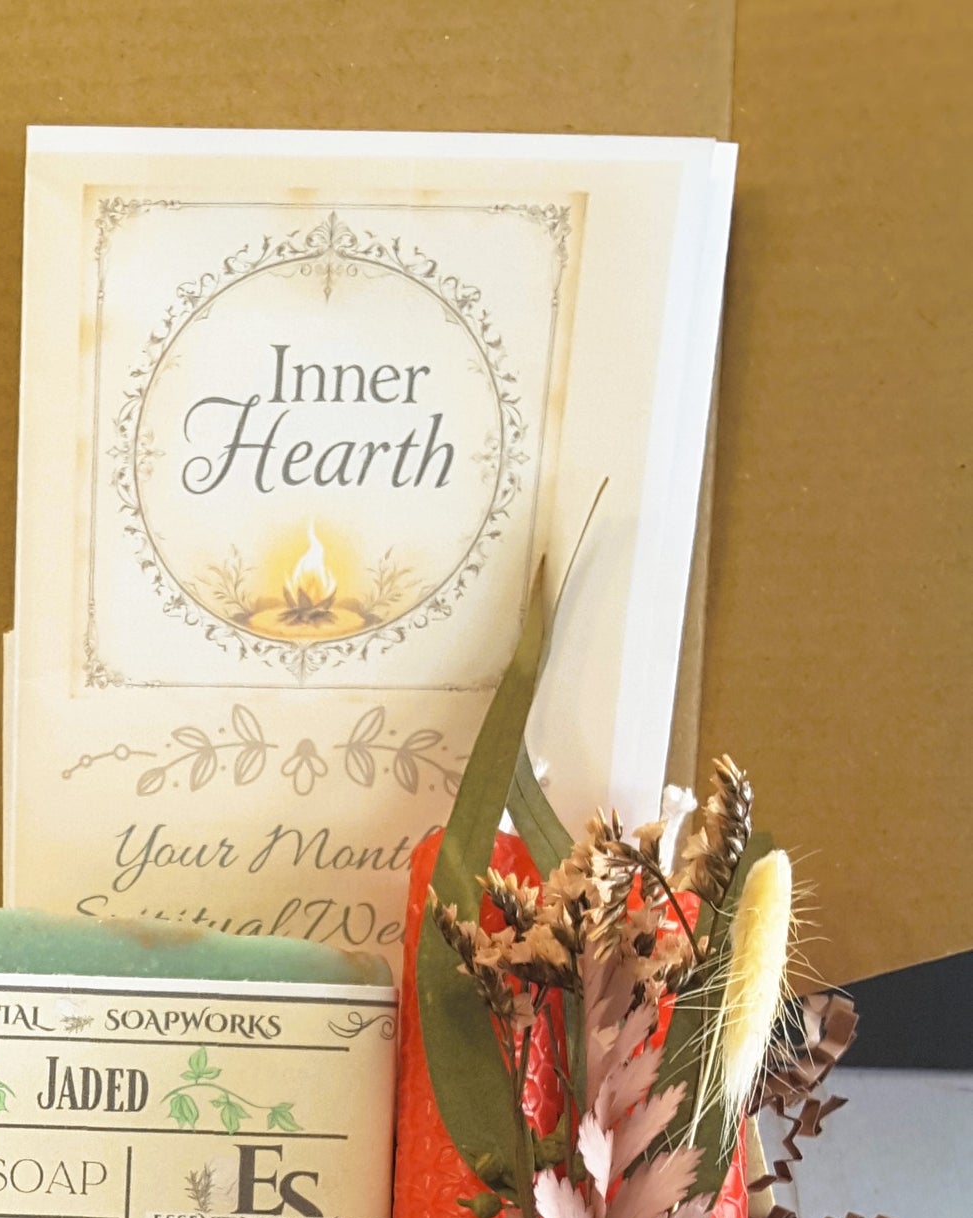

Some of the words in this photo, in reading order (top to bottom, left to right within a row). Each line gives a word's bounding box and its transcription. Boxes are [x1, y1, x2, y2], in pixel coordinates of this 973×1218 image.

[267, 344, 430, 404] Inner
[182, 394, 455, 494] Hearth
[112, 824, 238, 892] Your
[304, 898, 405, 946] We
[104, 1006, 282, 1038] SOAPWORKS
[37, 1056, 149, 1112] JADED
